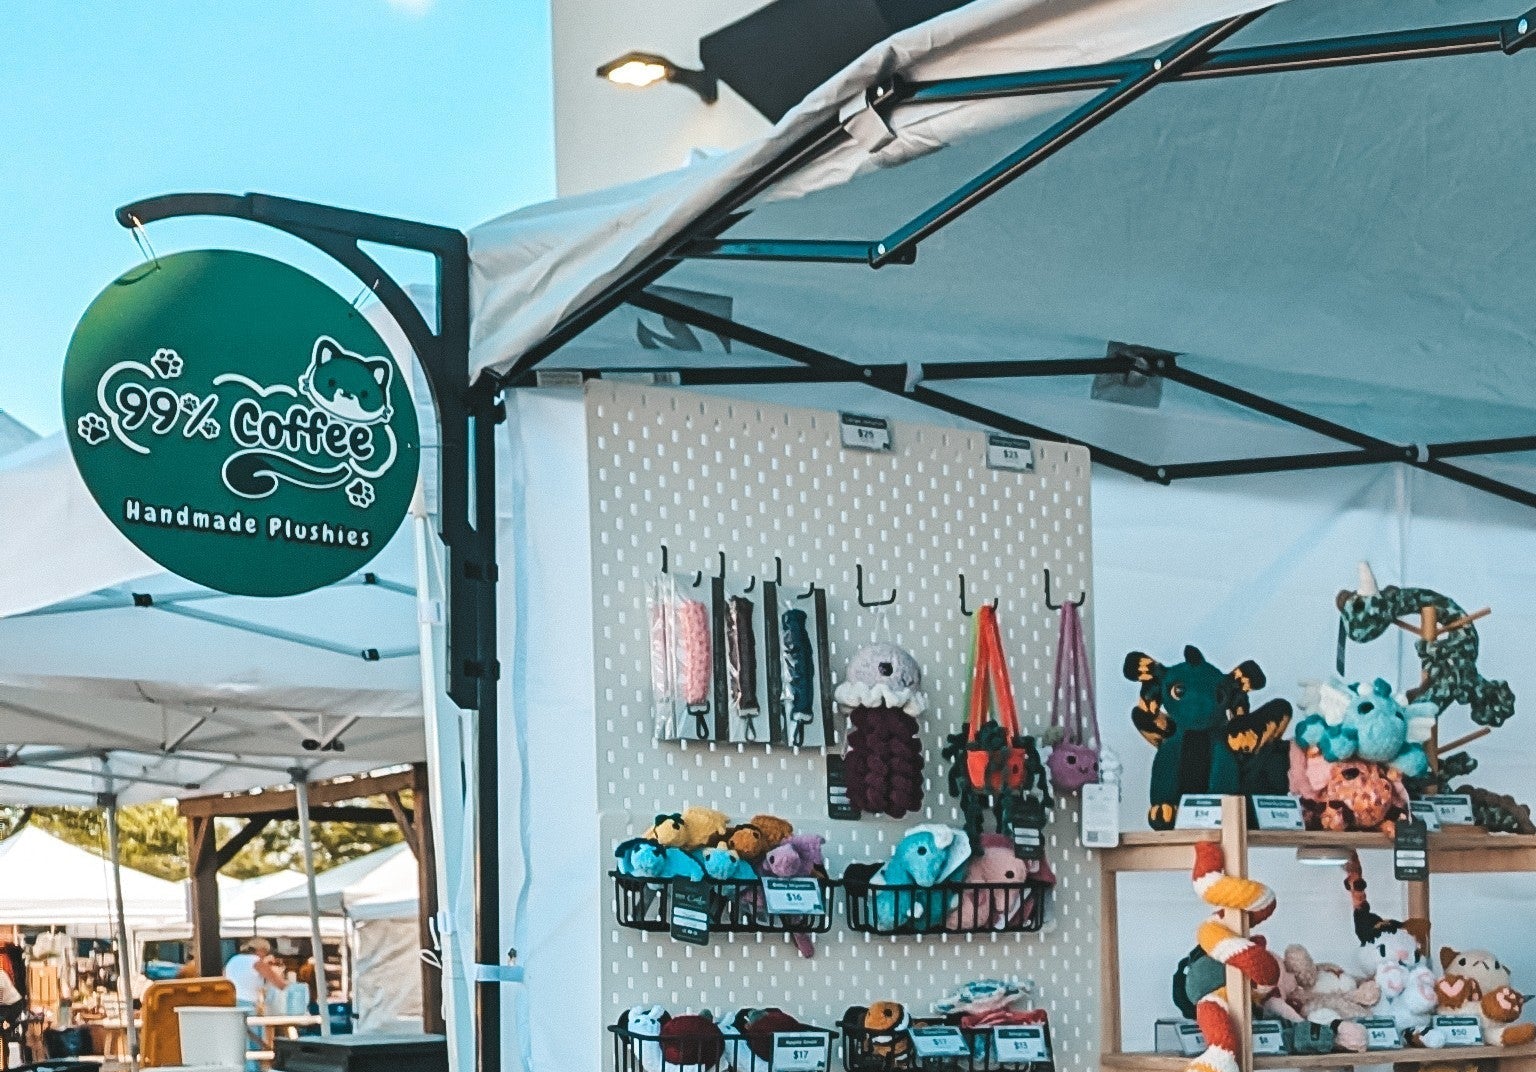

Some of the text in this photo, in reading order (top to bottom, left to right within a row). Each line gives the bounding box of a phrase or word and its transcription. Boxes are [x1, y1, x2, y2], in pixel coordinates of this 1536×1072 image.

[115, 383, 376, 461] 99% Coffee
[126, 500, 371, 548] Handmade Plushies
